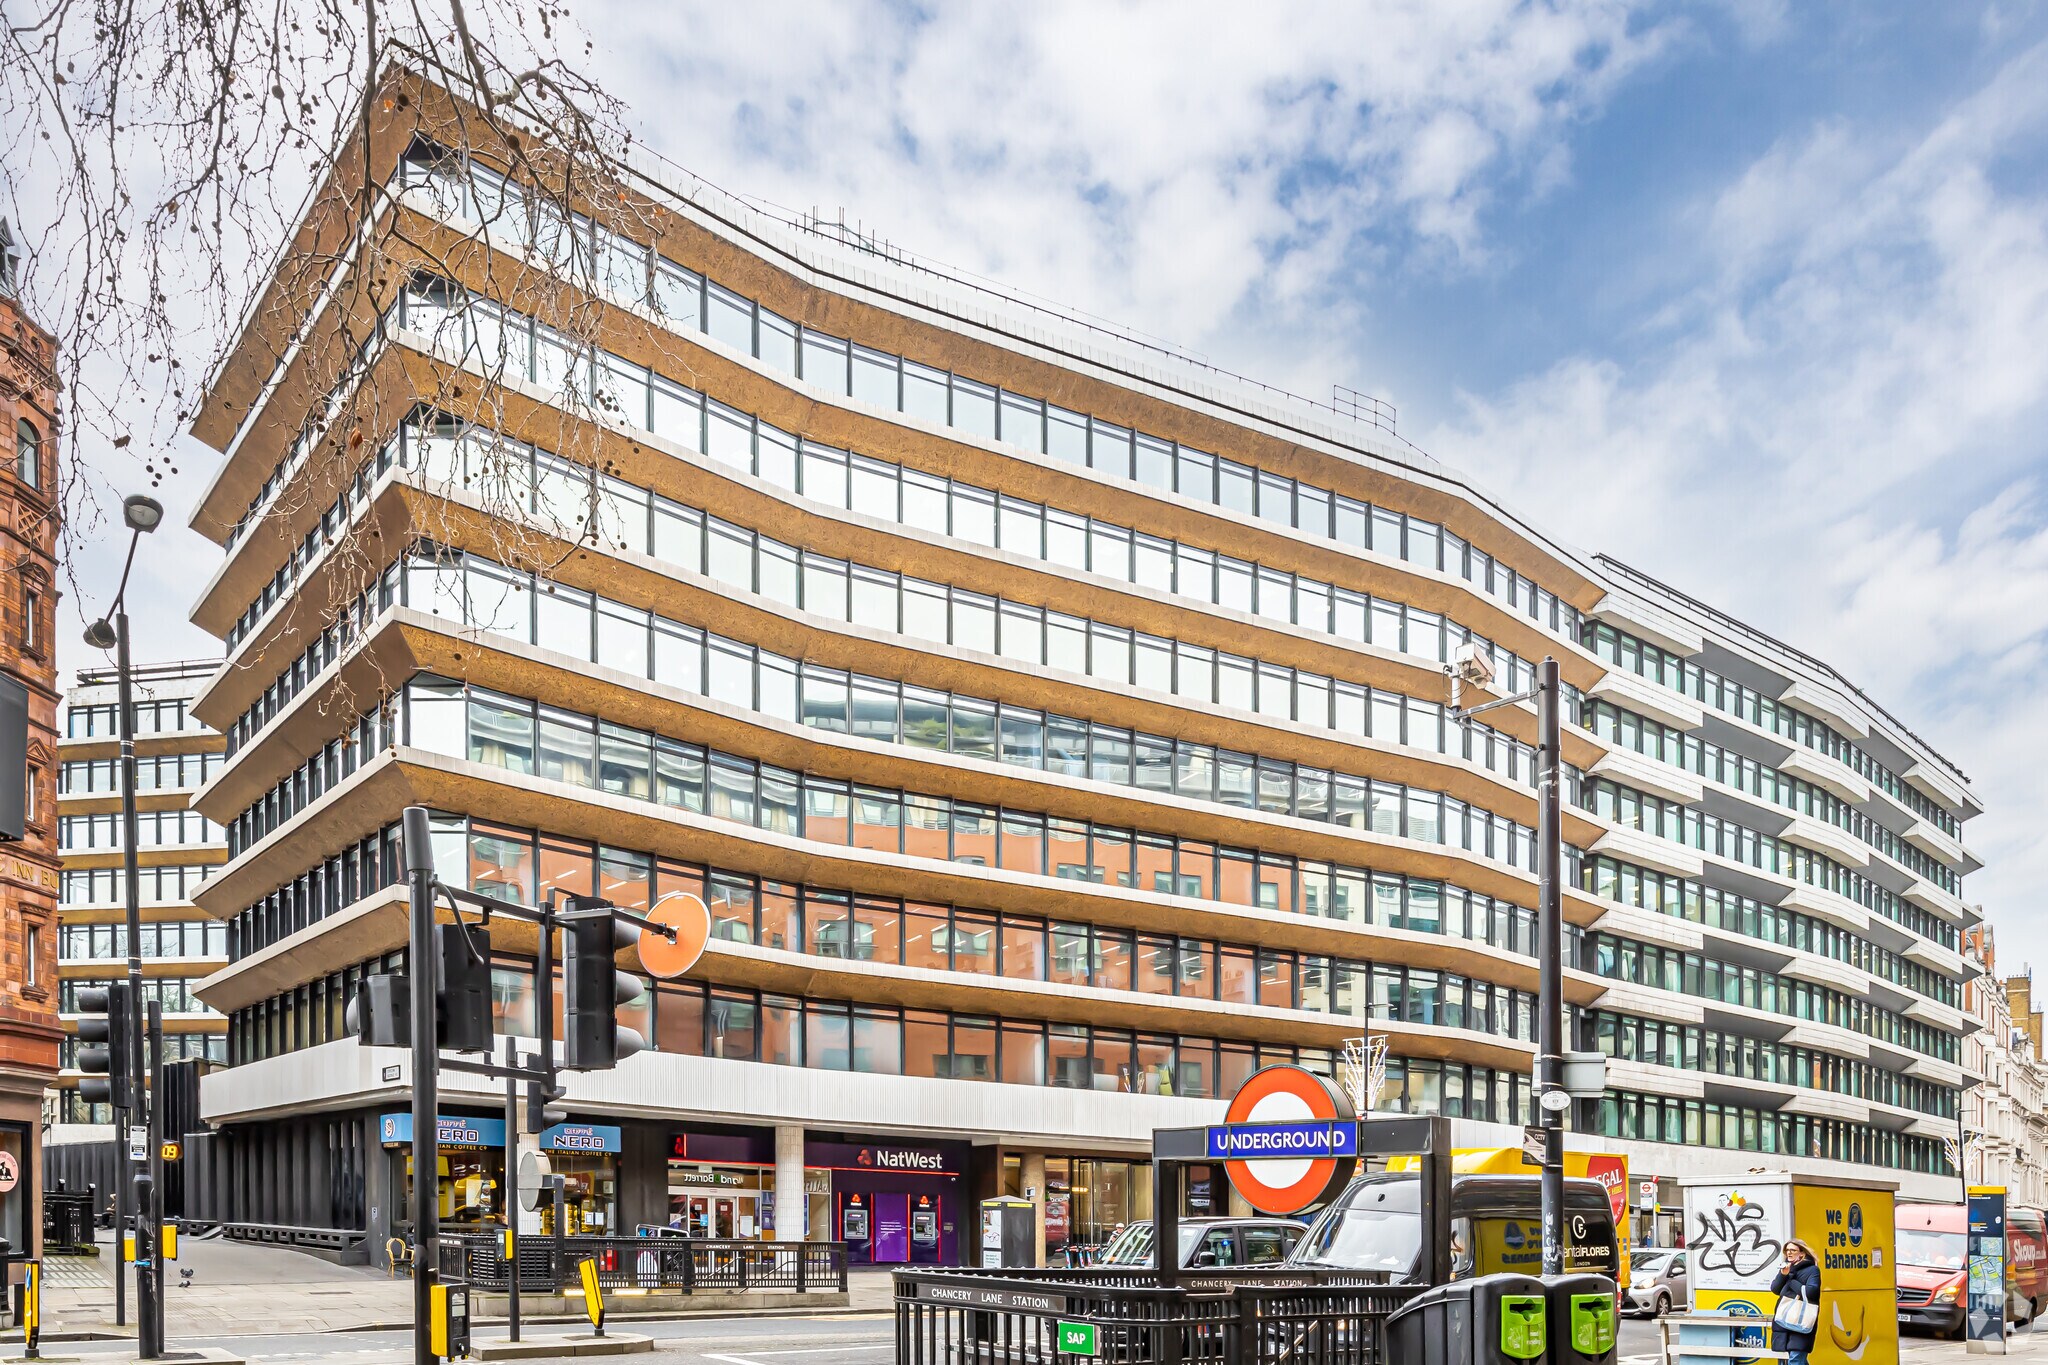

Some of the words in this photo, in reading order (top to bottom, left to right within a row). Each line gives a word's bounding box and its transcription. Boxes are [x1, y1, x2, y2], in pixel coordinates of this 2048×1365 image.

[11, 860, 34, 882] INN
[437, 1127, 479, 1143] ERO
[553, 1135, 605, 1149] NERO
[1217, 1130, 1346, 1150] UNDERGROUND
[162, 1144, 178, 1159] 09
[876, 1150, 943, 1169] NatWest
[1593, 1168, 1623, 1188] EGAL
[1825, 1209, 1842, 1225] we
[1828, 1231, 1847, 1247] are
[1824, 1248, 1869, 1269] bananas
[1191, 1280, 1232, 1288] CHANCERY
[1273, 1279, 1303, 1287] STATION
[931, 1288, 972, 1301] CHANCERY
[981, 1293, 1003, 1304] LANE
[1012, 1296, 1049, 1309] STATION
[1066, 1331, 1086, 1345] SAP
